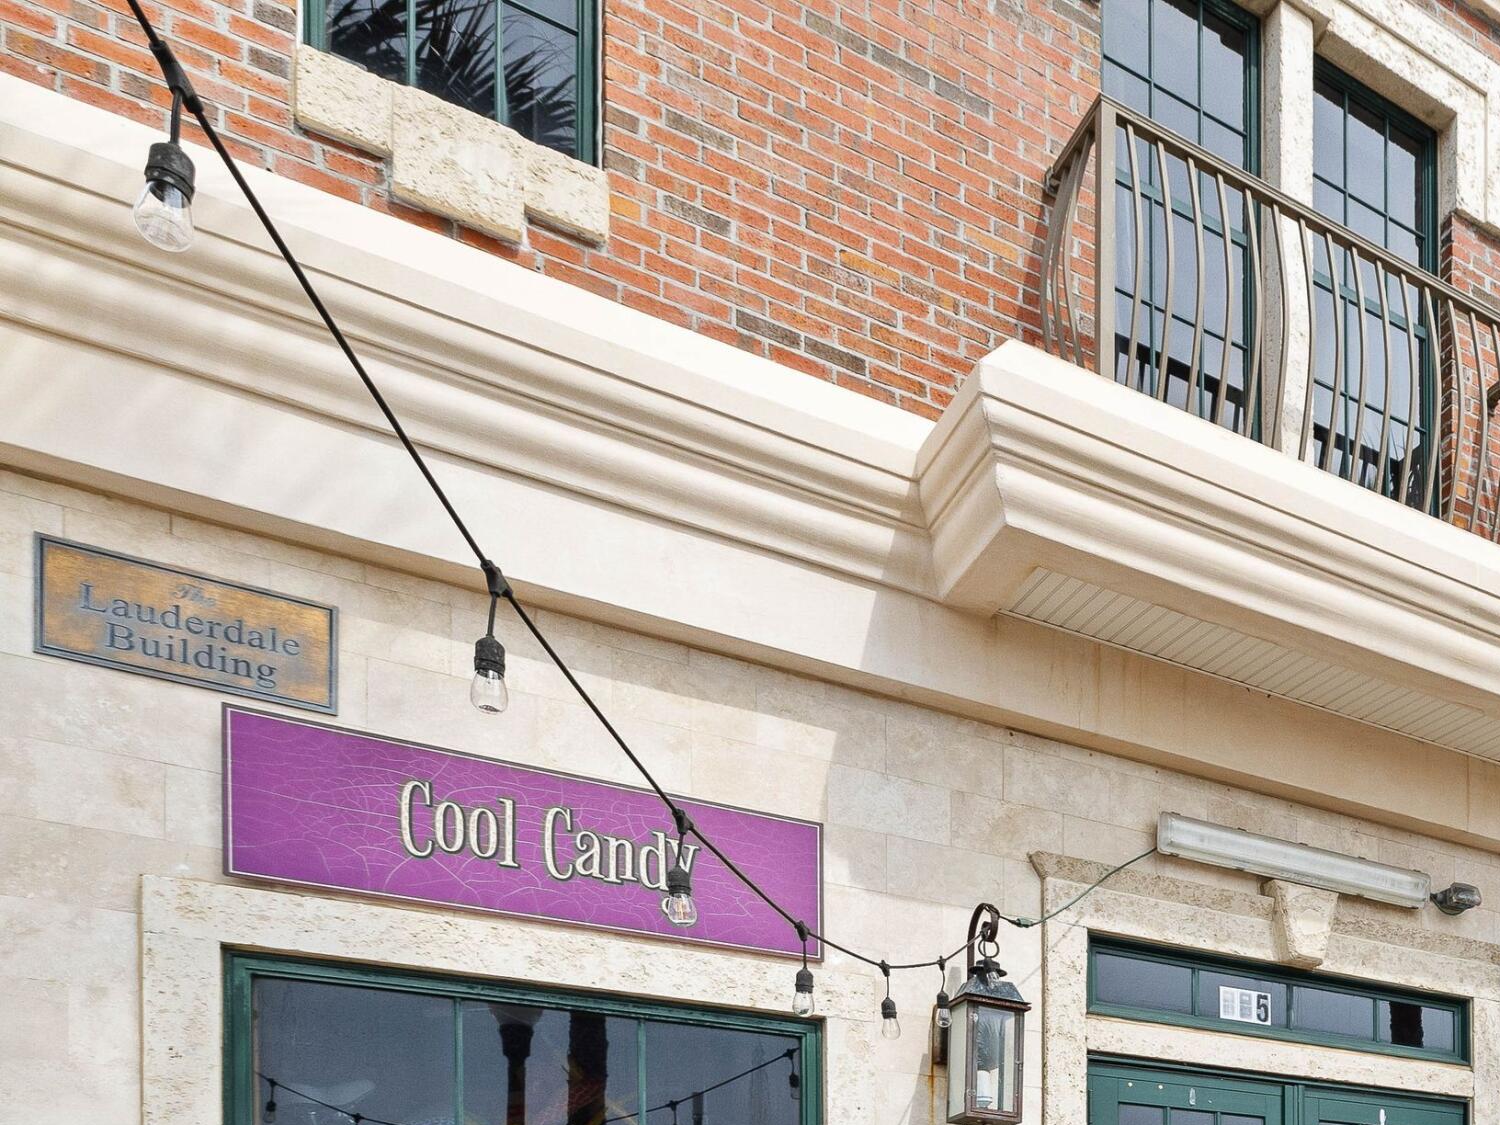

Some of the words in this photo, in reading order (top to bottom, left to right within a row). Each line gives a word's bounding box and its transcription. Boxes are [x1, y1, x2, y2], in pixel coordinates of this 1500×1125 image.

[79, 581, 301, 656] Lauderdale
[173, 582, 217, 608] The
[104, 621, 278, 690] Building
[400, 780, 520, 869] Cool
[543, 806, 699, 917] Candy
